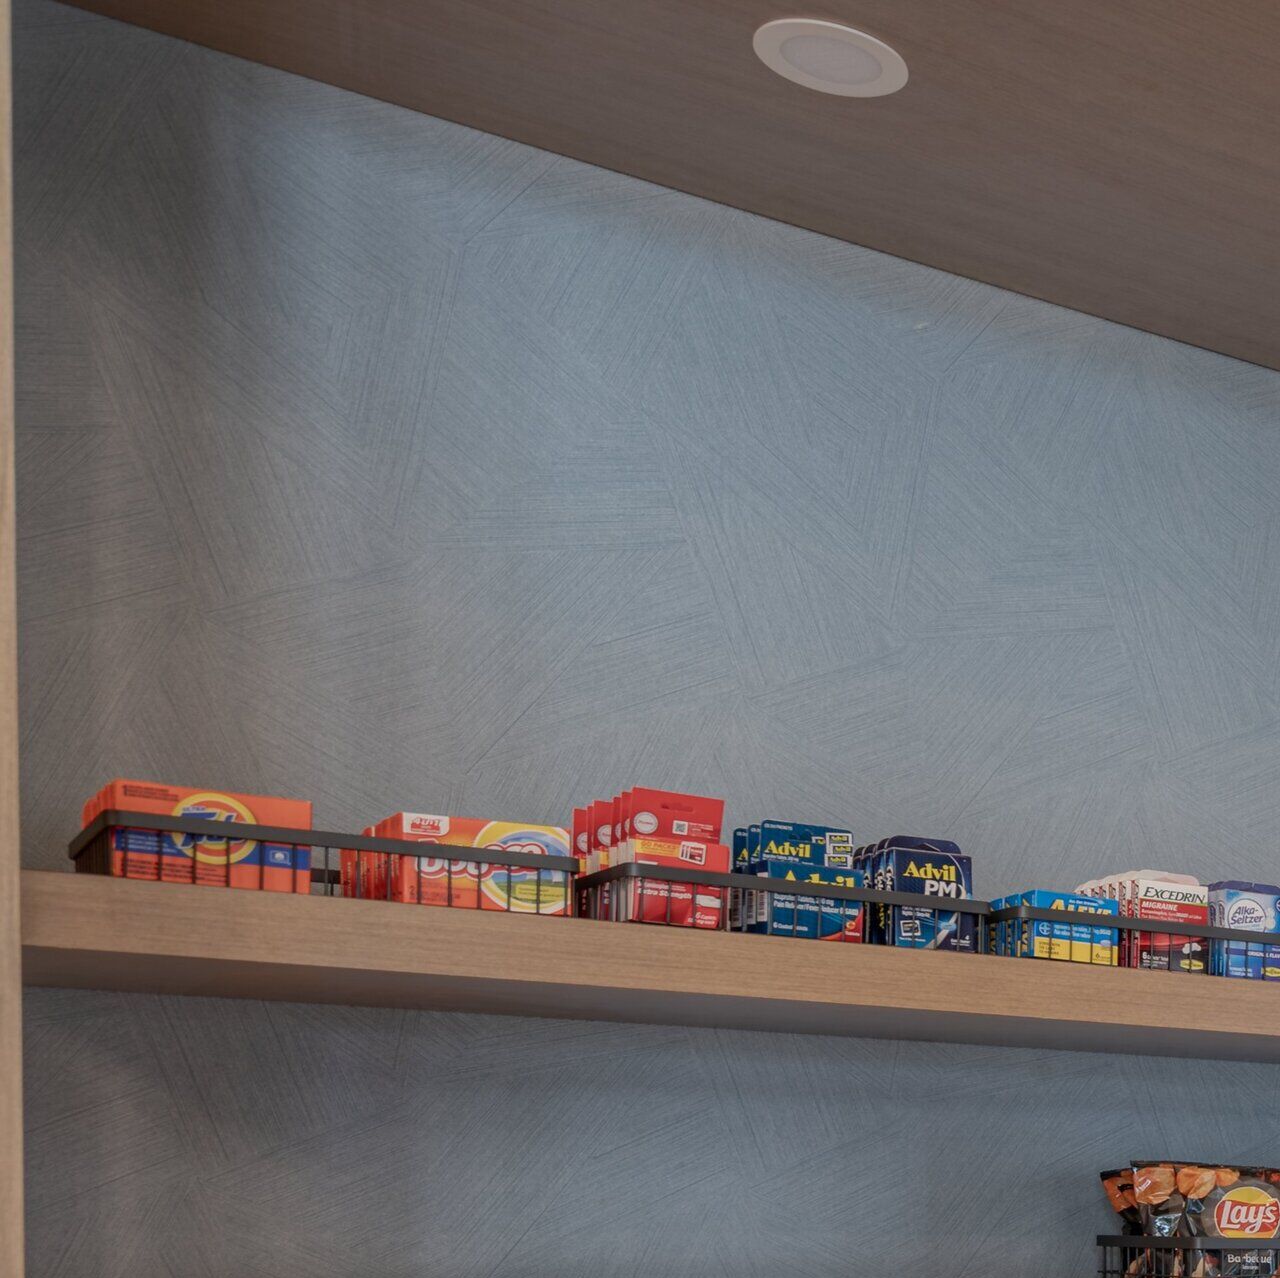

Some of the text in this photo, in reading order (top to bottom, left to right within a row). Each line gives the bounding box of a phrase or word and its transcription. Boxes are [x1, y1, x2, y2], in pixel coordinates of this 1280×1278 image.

[765, 840, 811, 858] Advil
[903, 861, 956, 881] Advil
[925, 880, 957, 899] PM
[1144, 887, 1206, 904] EXCEDRIN
[1141, 901, 1179, 911] MIGRAINE
[1233, 906, 1259, 915] Alka-
[1231, 915, 1264, 925] Seltzer
[1221, 1201, 1279, 1232] Lay's
